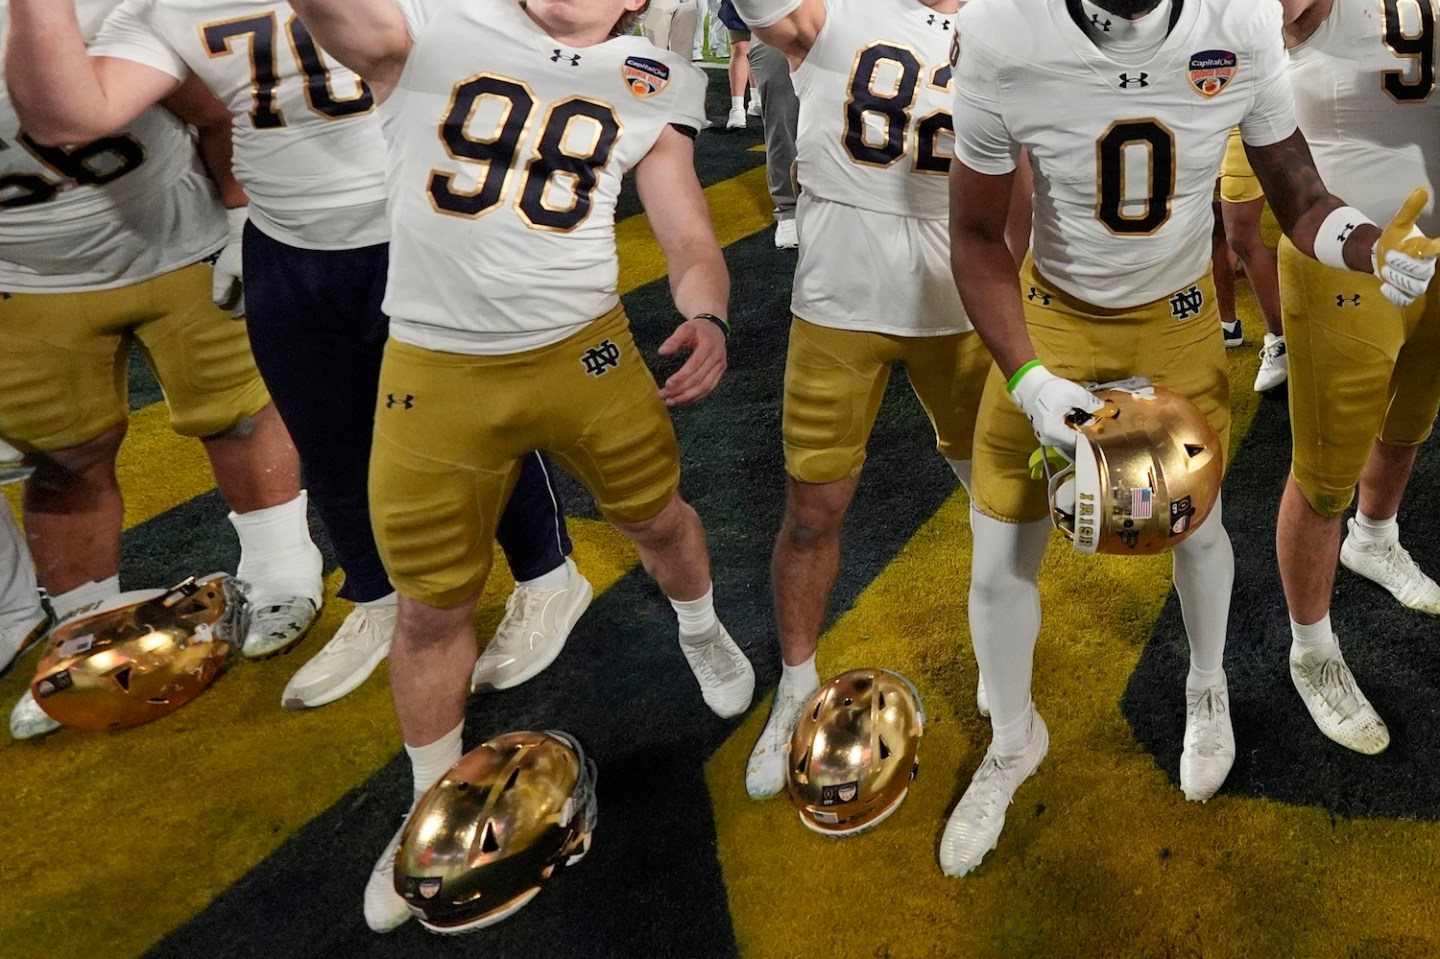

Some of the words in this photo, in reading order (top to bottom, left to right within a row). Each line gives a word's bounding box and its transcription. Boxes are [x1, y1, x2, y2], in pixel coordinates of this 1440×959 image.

[198, 10, 377, 132] 70
[841, 39, 954, 177] 82
[426, 71, 626, 234] 98
[1094, 116, 1177, 237] 0
[1078, 491, 1095, 548] IRISH
